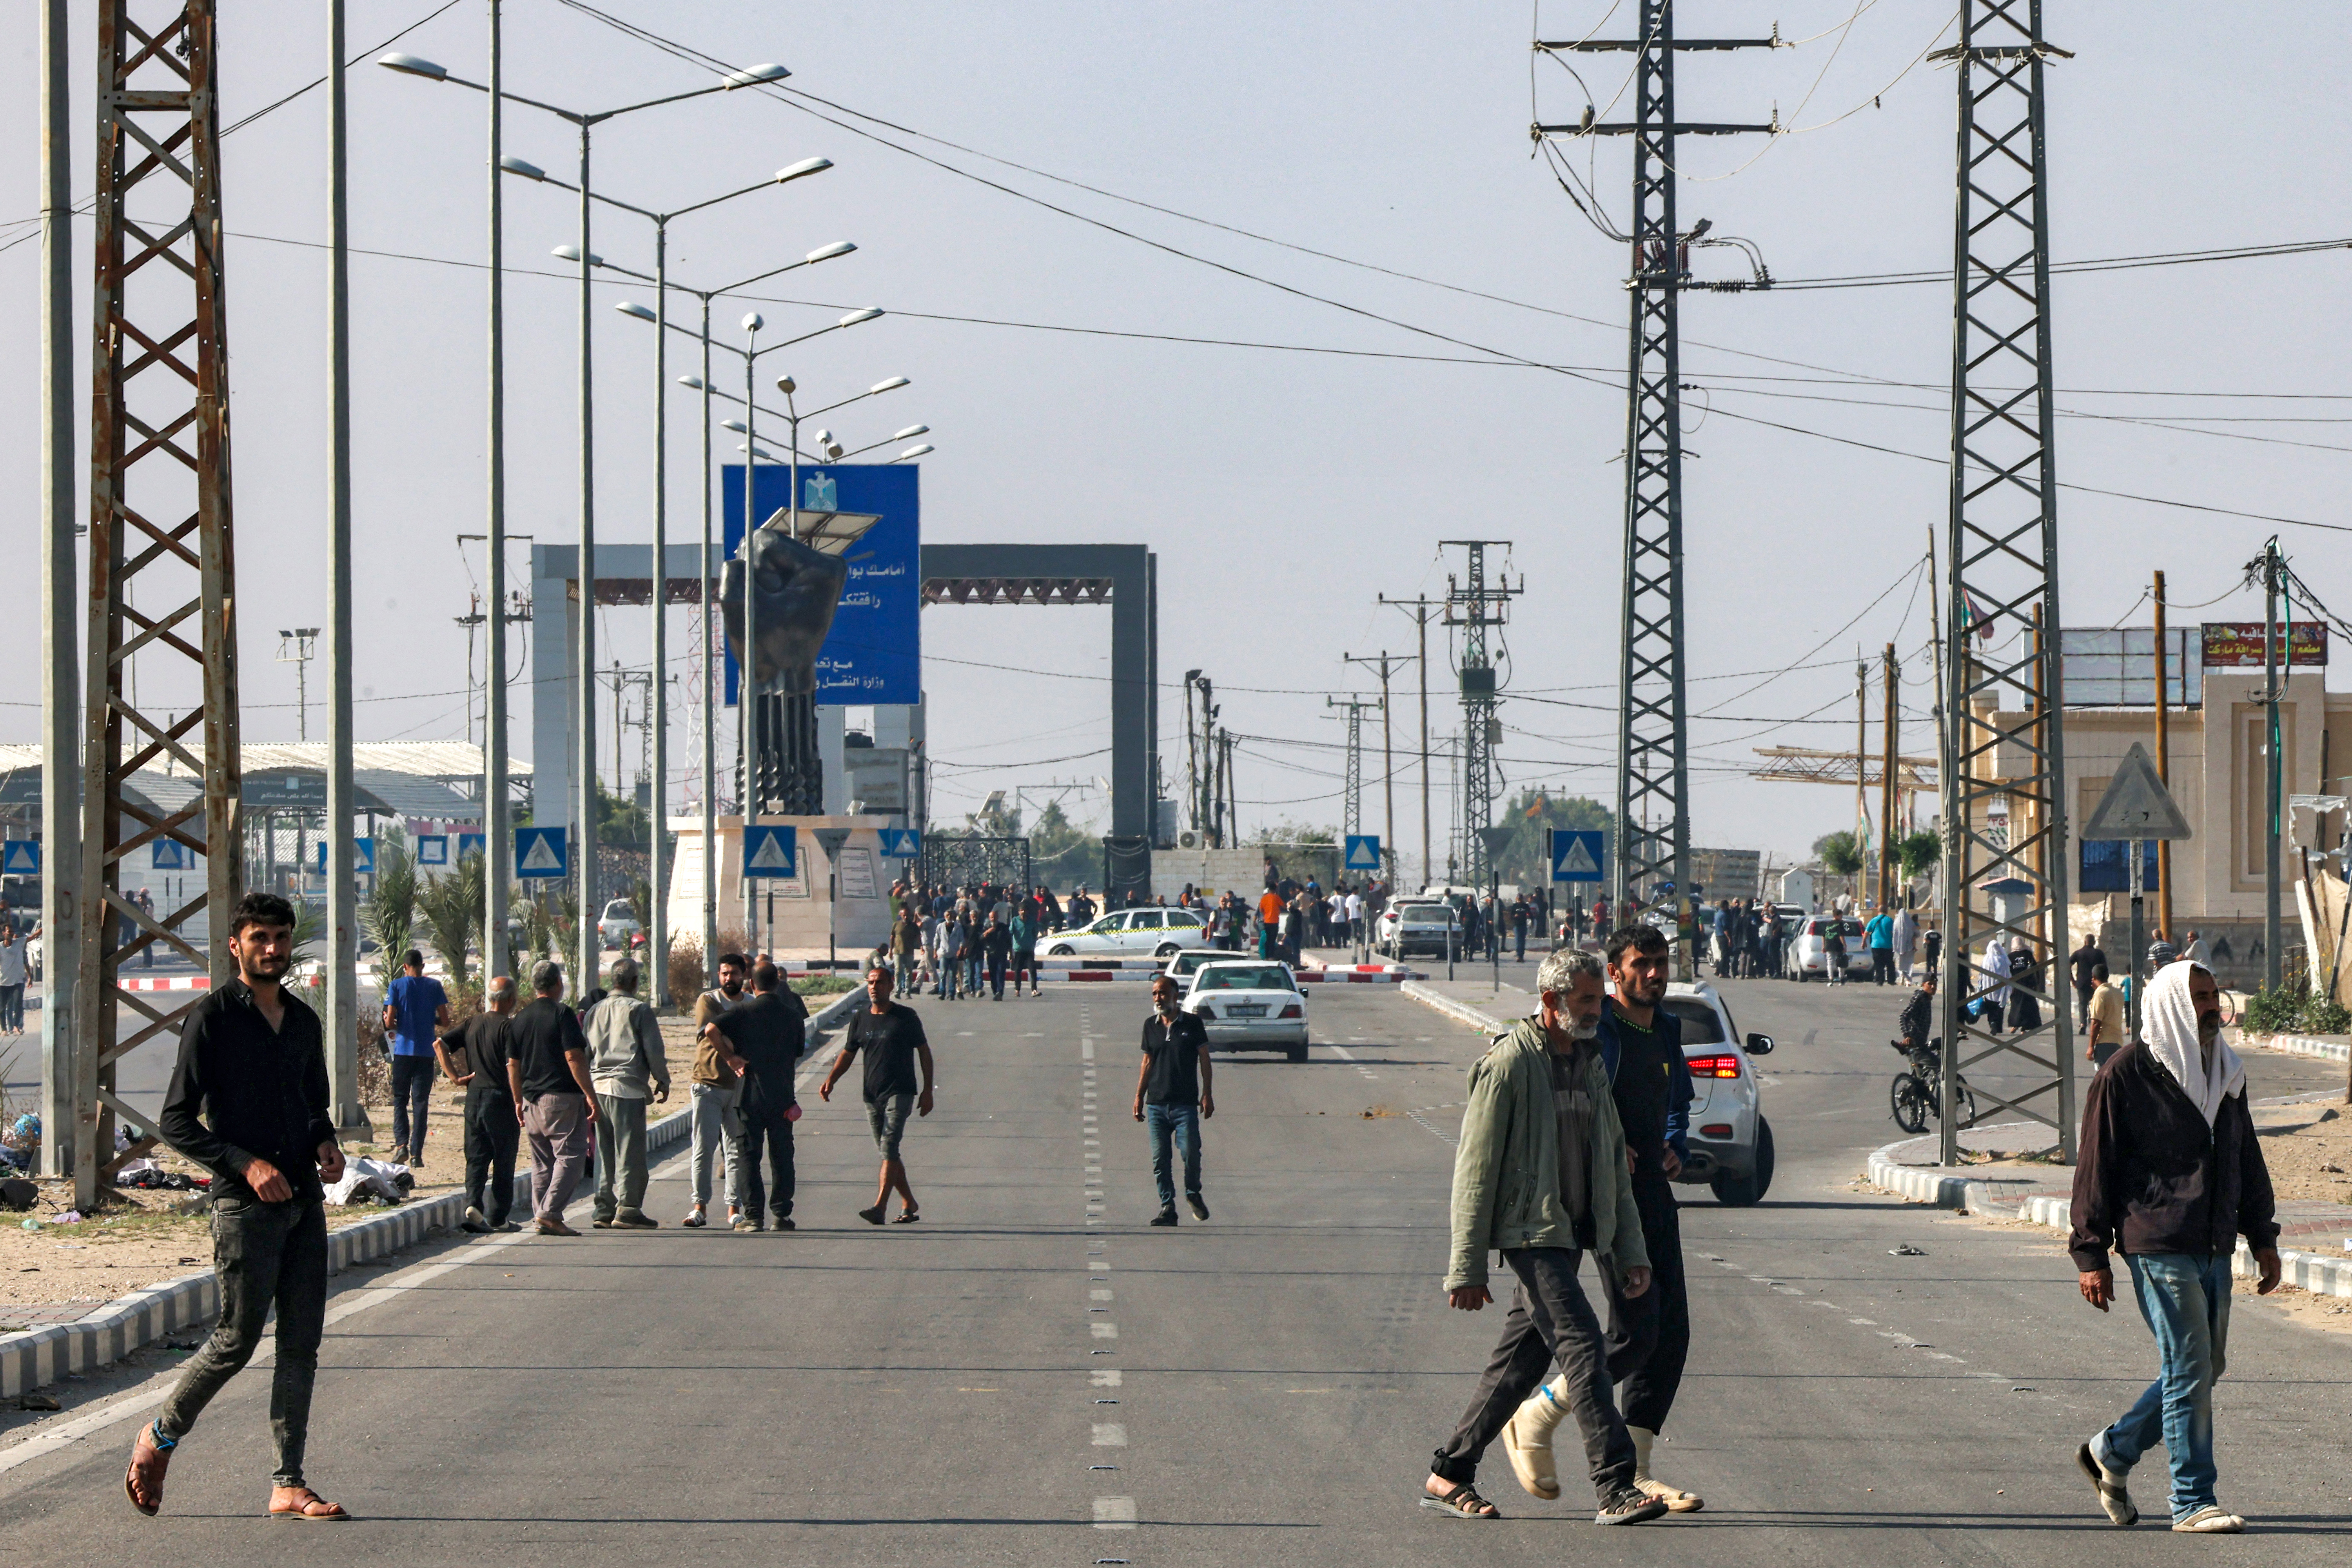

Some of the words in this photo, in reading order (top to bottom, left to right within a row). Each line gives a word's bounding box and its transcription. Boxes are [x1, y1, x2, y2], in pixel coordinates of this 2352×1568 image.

[848, 565, 864, 580] بوا
[866, 562, 905, 576] أمامك
[837, 591, 881, 609] رافقتك
[2207, 644, 2234, 656] ماركت
[2235, 643, 2263, 656] صرافة
[833, 660, 853, 673] مع
[821, 675, 859, 689] النقل
[862, 676, 884, 689] وزارة
